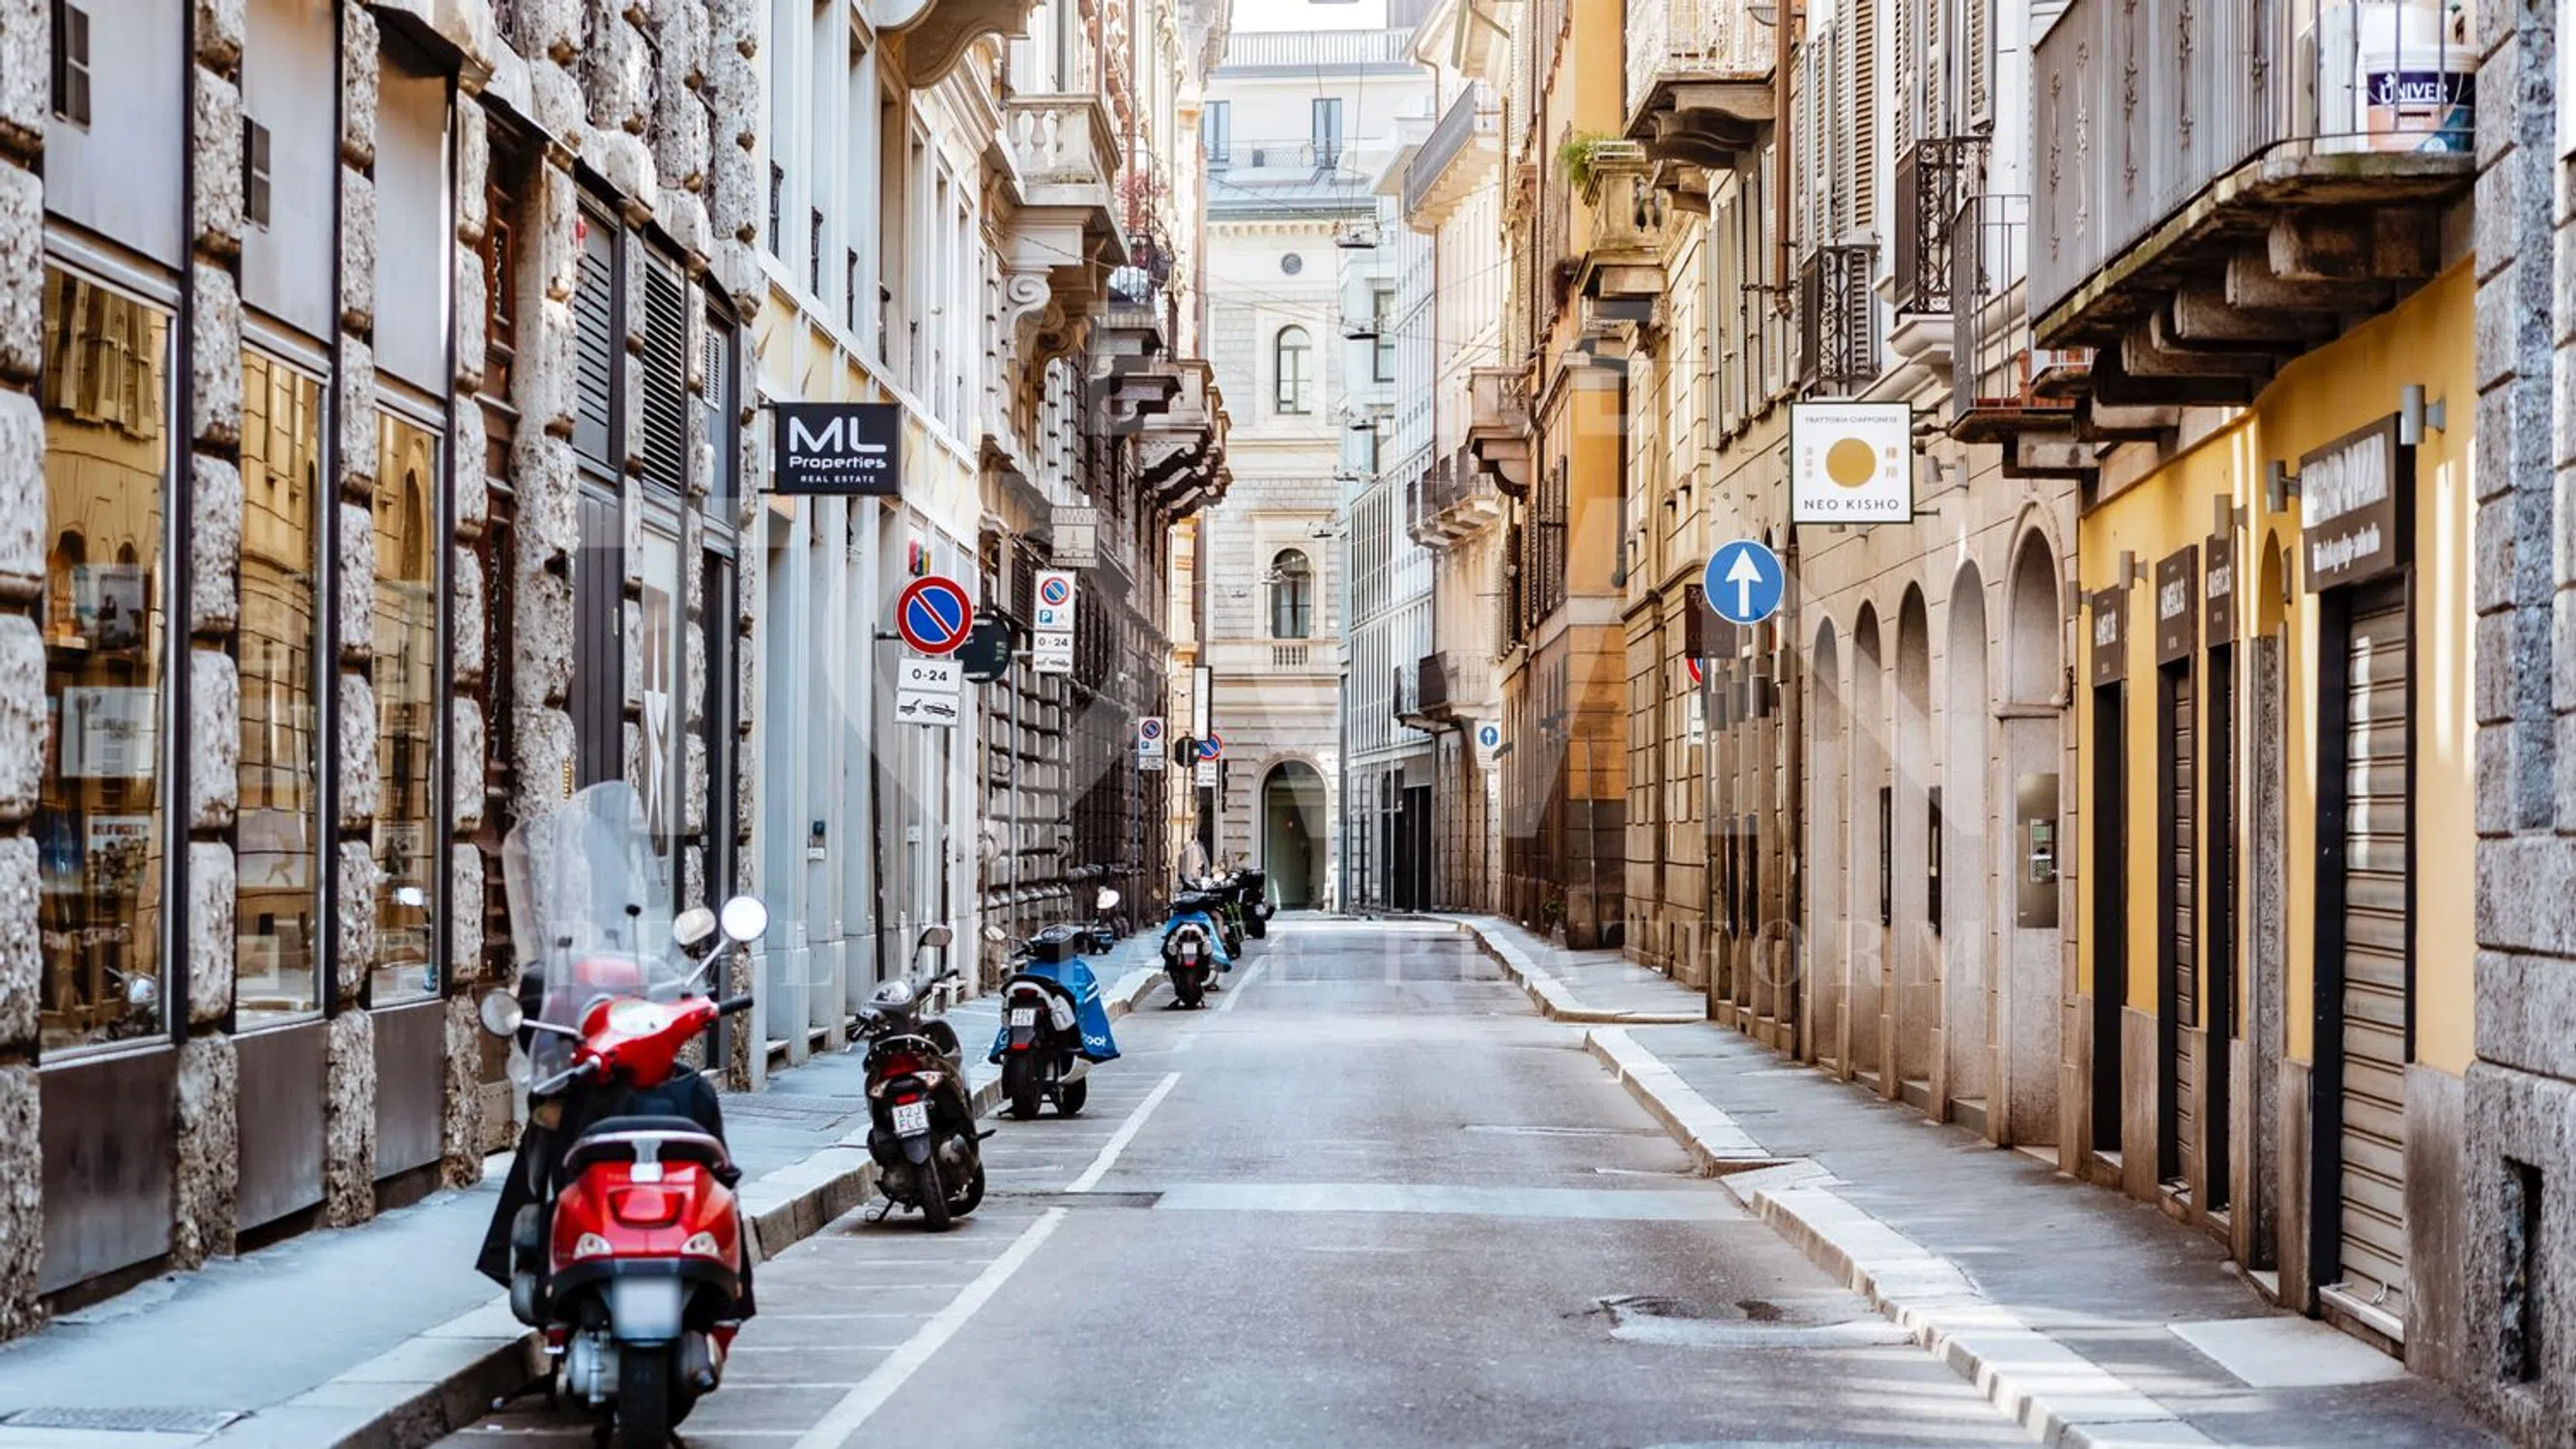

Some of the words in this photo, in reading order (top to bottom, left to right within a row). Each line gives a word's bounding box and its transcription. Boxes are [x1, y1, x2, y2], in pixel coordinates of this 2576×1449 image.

[789, 416, 887, 453] ML
[789, 456, 887, 469] Properties
[1804, 499, 1839, 510] NEO
[1846, 499, 1900, 510] KISHO
